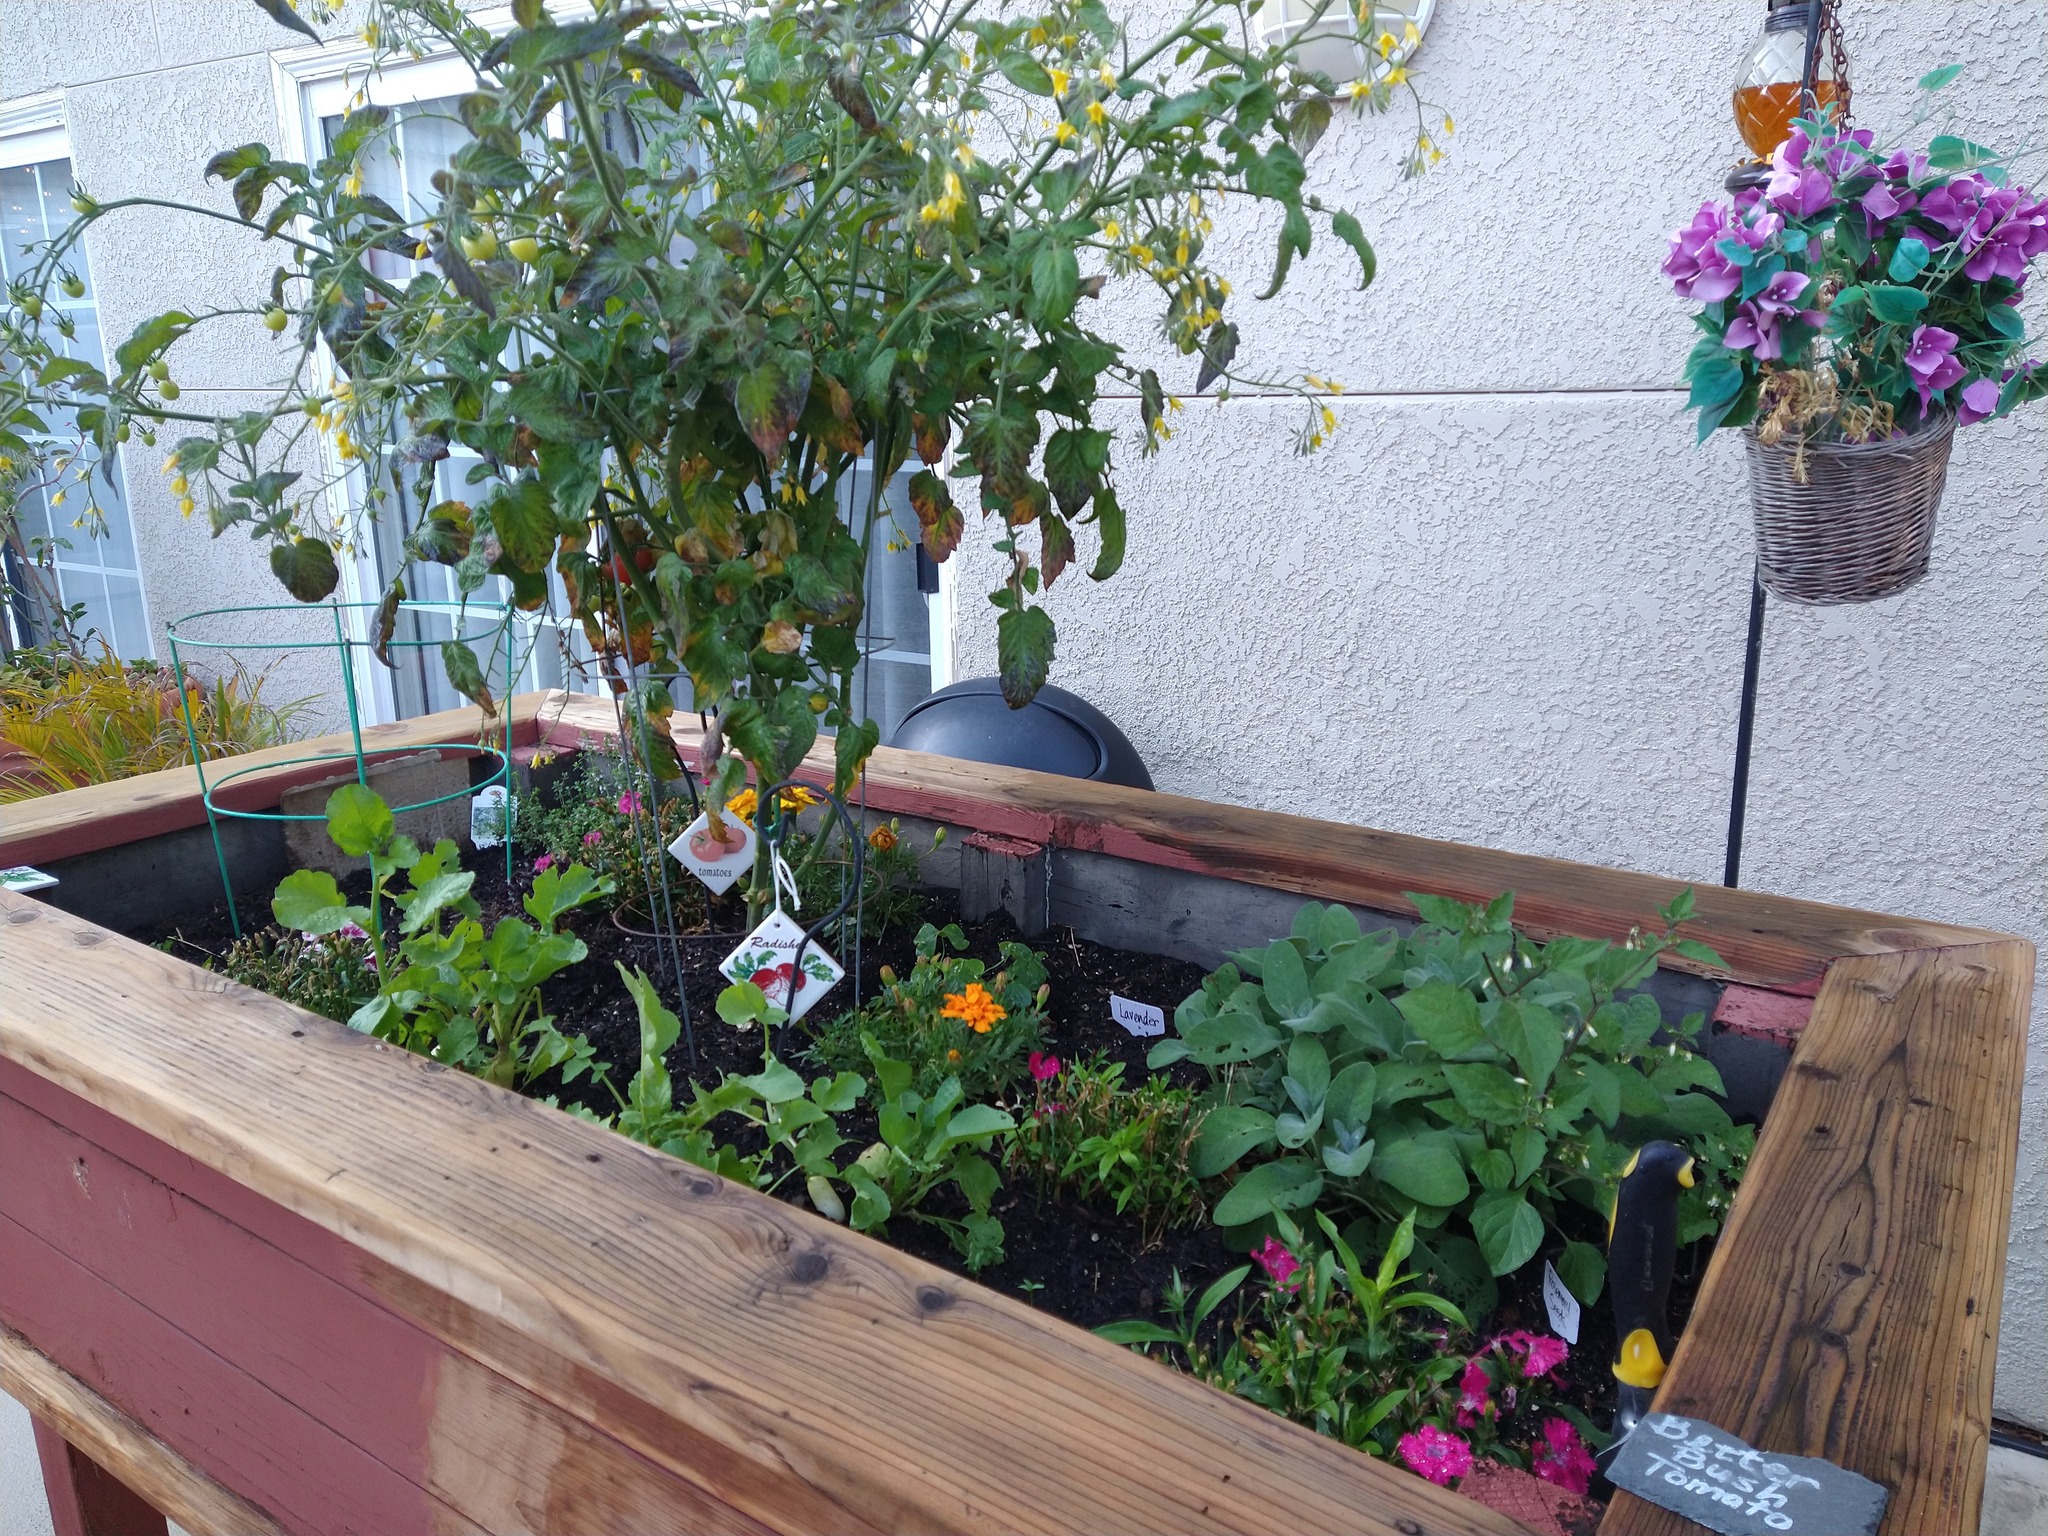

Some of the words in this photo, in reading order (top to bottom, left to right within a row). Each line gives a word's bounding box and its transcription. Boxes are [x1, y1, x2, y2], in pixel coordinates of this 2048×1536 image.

[698, 868, 732, 877] tomatoes
[750, 936, 808, 950] Radishe
[1119, 1003, 1160, 1027] Lavender
[1649, 1415, 1820, 1491] Better
[1645, 1451, 1794, 1530] Tomato
[1671, 1444, 1789, 1508] Bush
